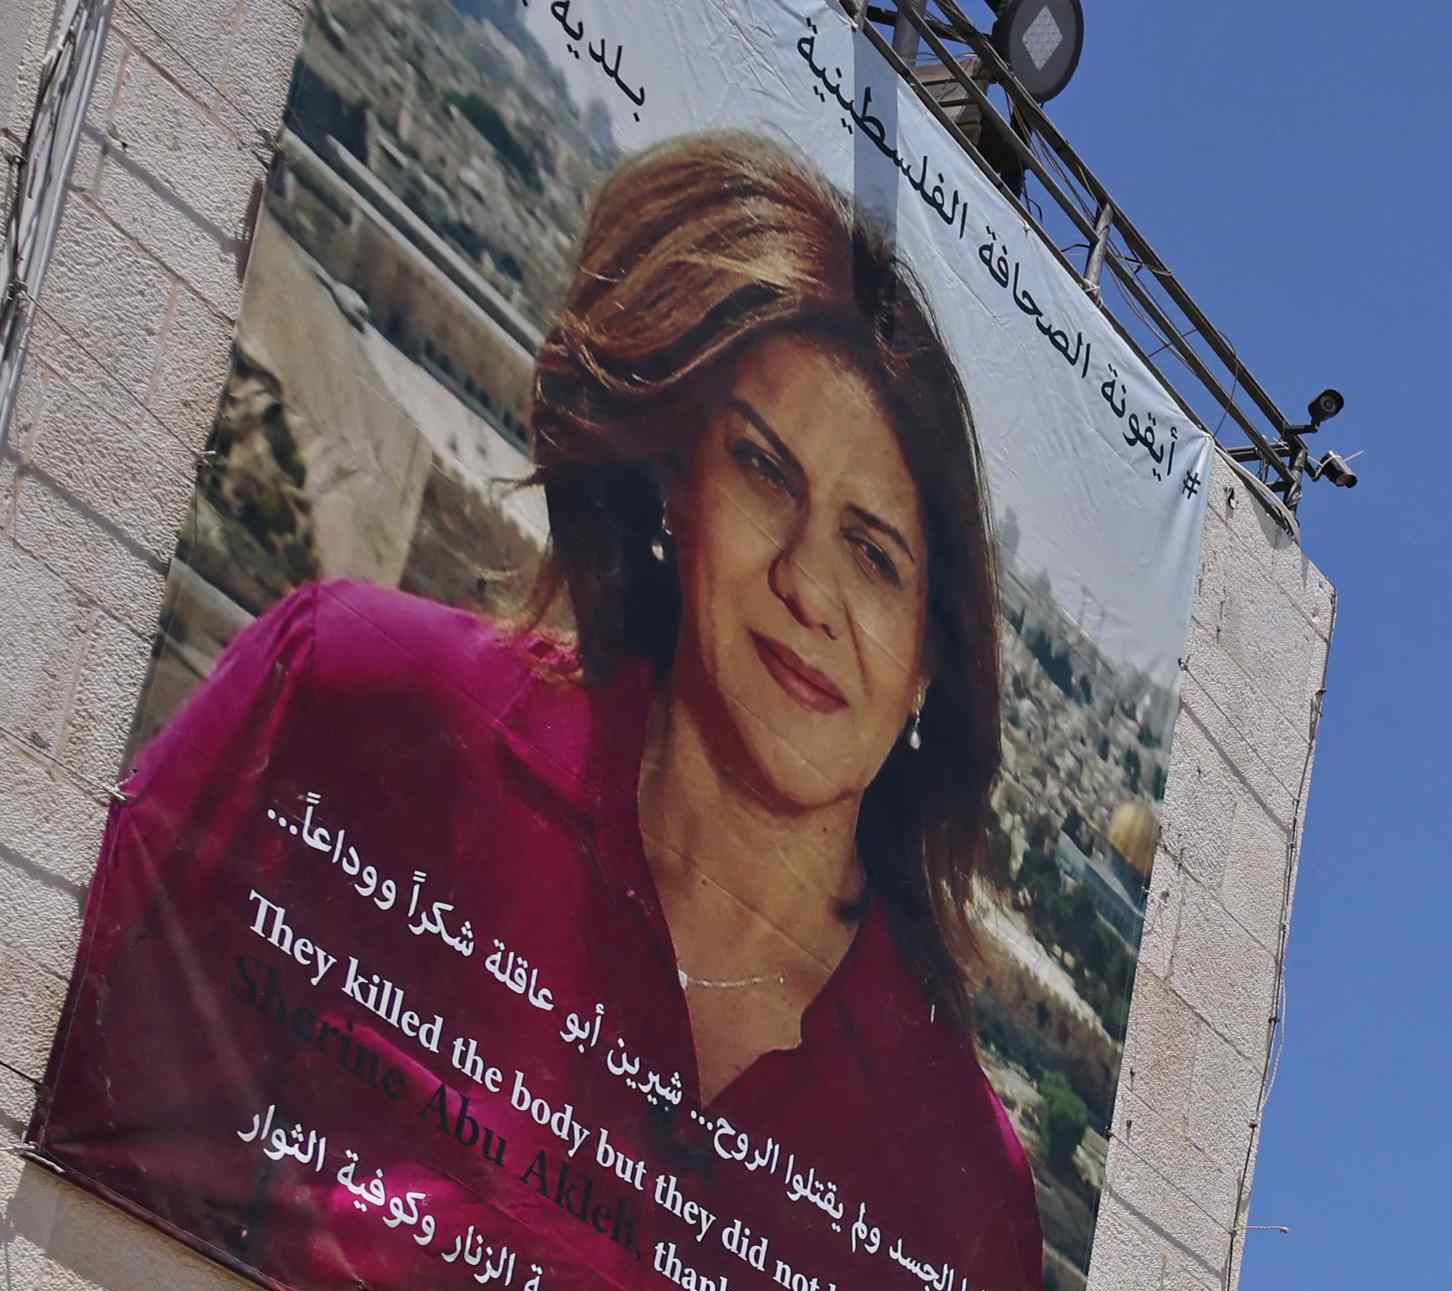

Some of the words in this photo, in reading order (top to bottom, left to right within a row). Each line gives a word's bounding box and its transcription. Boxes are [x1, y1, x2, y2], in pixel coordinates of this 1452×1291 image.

[797, 18, 968, 239] الفلسطينية
[979, 226, 1090, 378] الصحافة
[485, 939, 553, 1010] عاقلة
[560, 1004, 604, 1052] أبو
[250, 890, 336, 985] They
[342, 957, 443, 1053] killed
[452, 1038, 502, 1092] the
[512, 1071, 590, 1157] body
[597, 1128, 646, 1190] but
[655, 1175, 716, 1241] they
[722, 1220, 768, 1271] did
[607, 1038, 683, 1112] شيرين
[237, 1105, 325, 1171] الثوار
[421, 1084, 506, 1168] Abu
[337, 1150, 435, 1245] وكوفية
[786, 1155, 843, 1232] يقتلوا
[852, 1203, 880, 1253] ولم
[442, 1226, 515, 1286] الزنار
